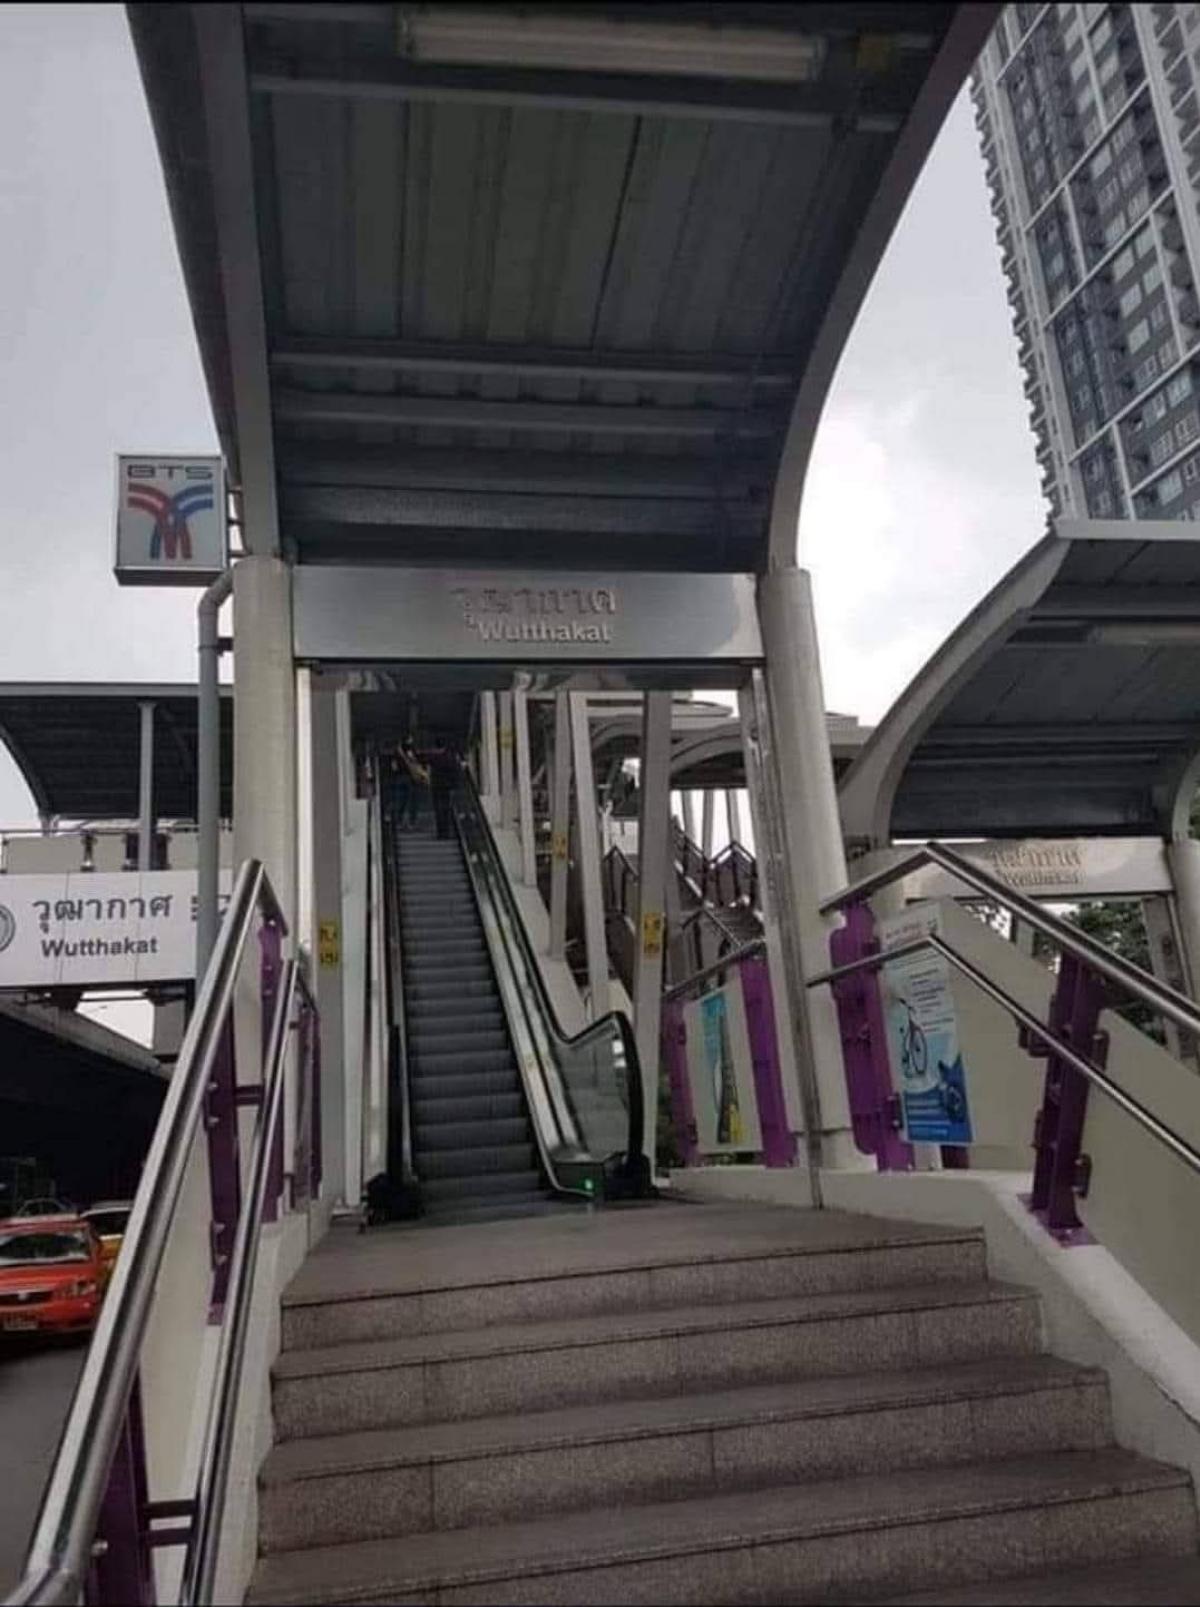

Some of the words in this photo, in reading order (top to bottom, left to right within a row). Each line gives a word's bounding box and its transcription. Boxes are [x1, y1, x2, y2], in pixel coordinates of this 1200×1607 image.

[127, 464, 213, 479] BTS
[478, 620, 612, 643] Wutthakat
[33, 895, 172, 933] วุฒากาศ
[41, 937, 157, 957] Wutthakat
